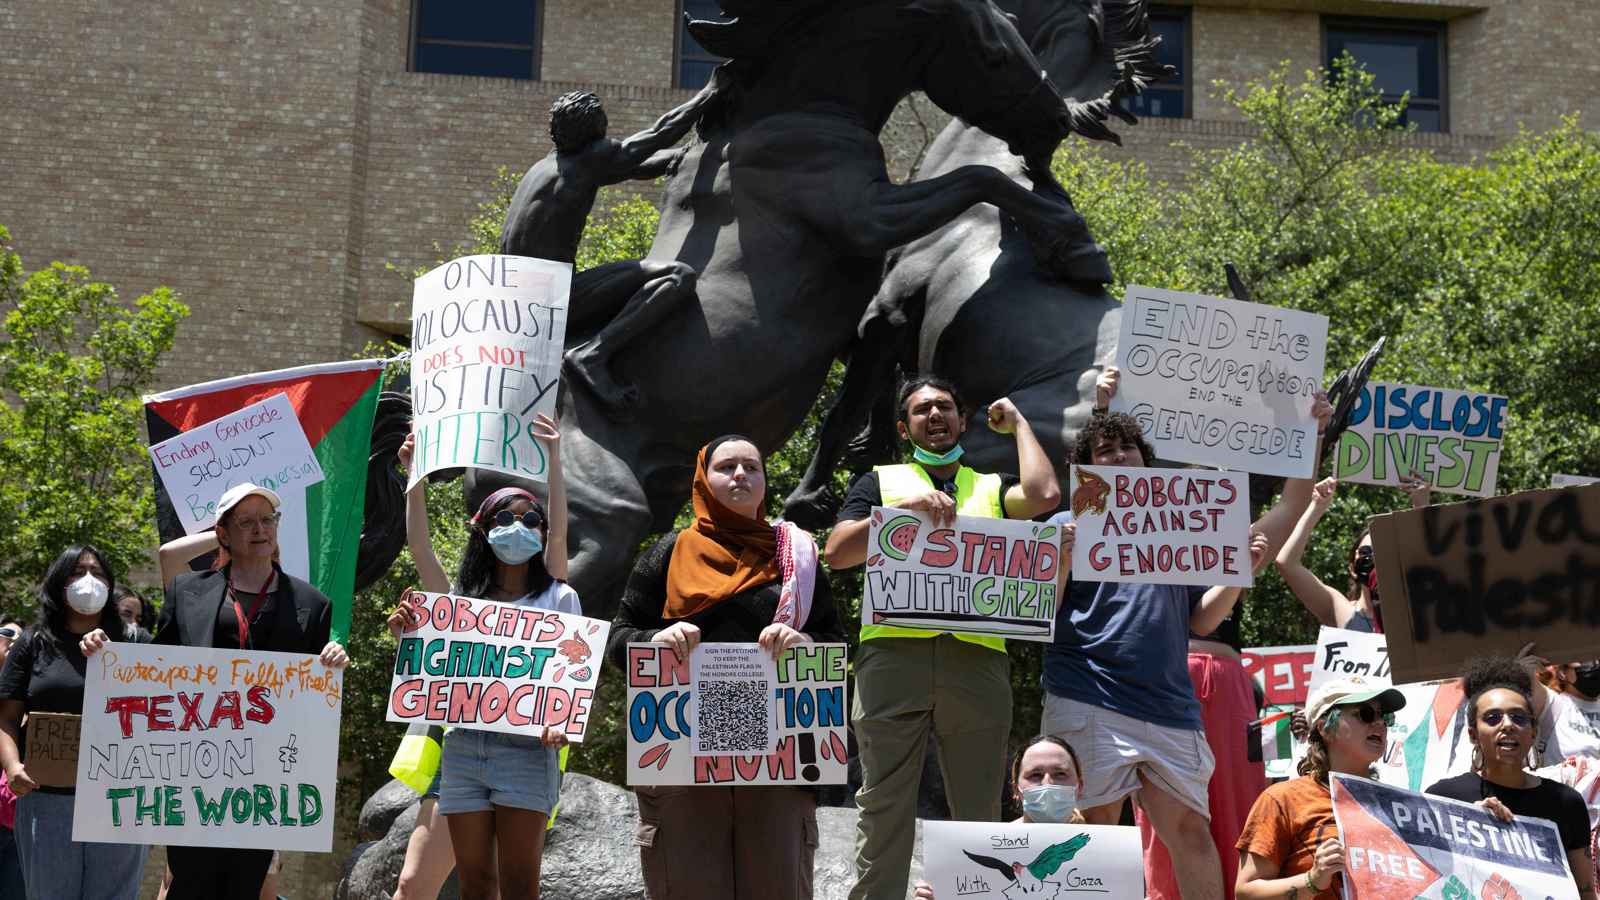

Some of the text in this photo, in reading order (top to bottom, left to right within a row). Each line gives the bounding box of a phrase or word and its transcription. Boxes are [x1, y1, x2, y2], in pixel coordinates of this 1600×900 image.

[444, 256, 518, 290] ONE
[1131, 296, 1310, 362] END the
[423, 345, 527, 374] DOES NOT
[412, 363, 557, 417] USTIFY
[1188, 387, 1243, 407] END THE
[1349, 385, 1509, 439] DISCLOSE
[154, 404, 283, 469] Ending Genocide
[416, 411, 546, 478] OHTERS
[1130, 402, 1305, 459] GENOCIDE
[1336, 430, 1500, 491] DIVEST
[185, 494, 216, 521] Be
[1115, 474, 1238, 508] BOBCATS
[1102, 508, 1225, 537] AGAINST
[920, 529, 1058, 580] STAND
[1088, 541, 1239, 576] GENOCIDE
[404, 592, 565, 642] BOBCATS
[868, 570, 1056, 620] WITH GAZA
[102, 651, 218, 689] Participate
[231, 659, 281, 698] Fully
[396, 638, 556, 680] AGAINST
[630, 646, 846, 688] EN THE
[1323, 641, 1370, 676] From
[105, 685, 275, 738] TEXAS
[391, 680, 593, 735] GENOCIDE
[629, 687, 845, 743] OCCION
[88, 738, 254, 780] NATION
[694, 732, 821, 784] NOW!
[105, 784, 323, 827] THE WORLD
[991, 832, 1029, 848] Stand
[1390, 800, 1551, 863] PALESTINE
[956, 868, 1104, 892] With Gaza
[1349, 845, 1425, 880] FREE
